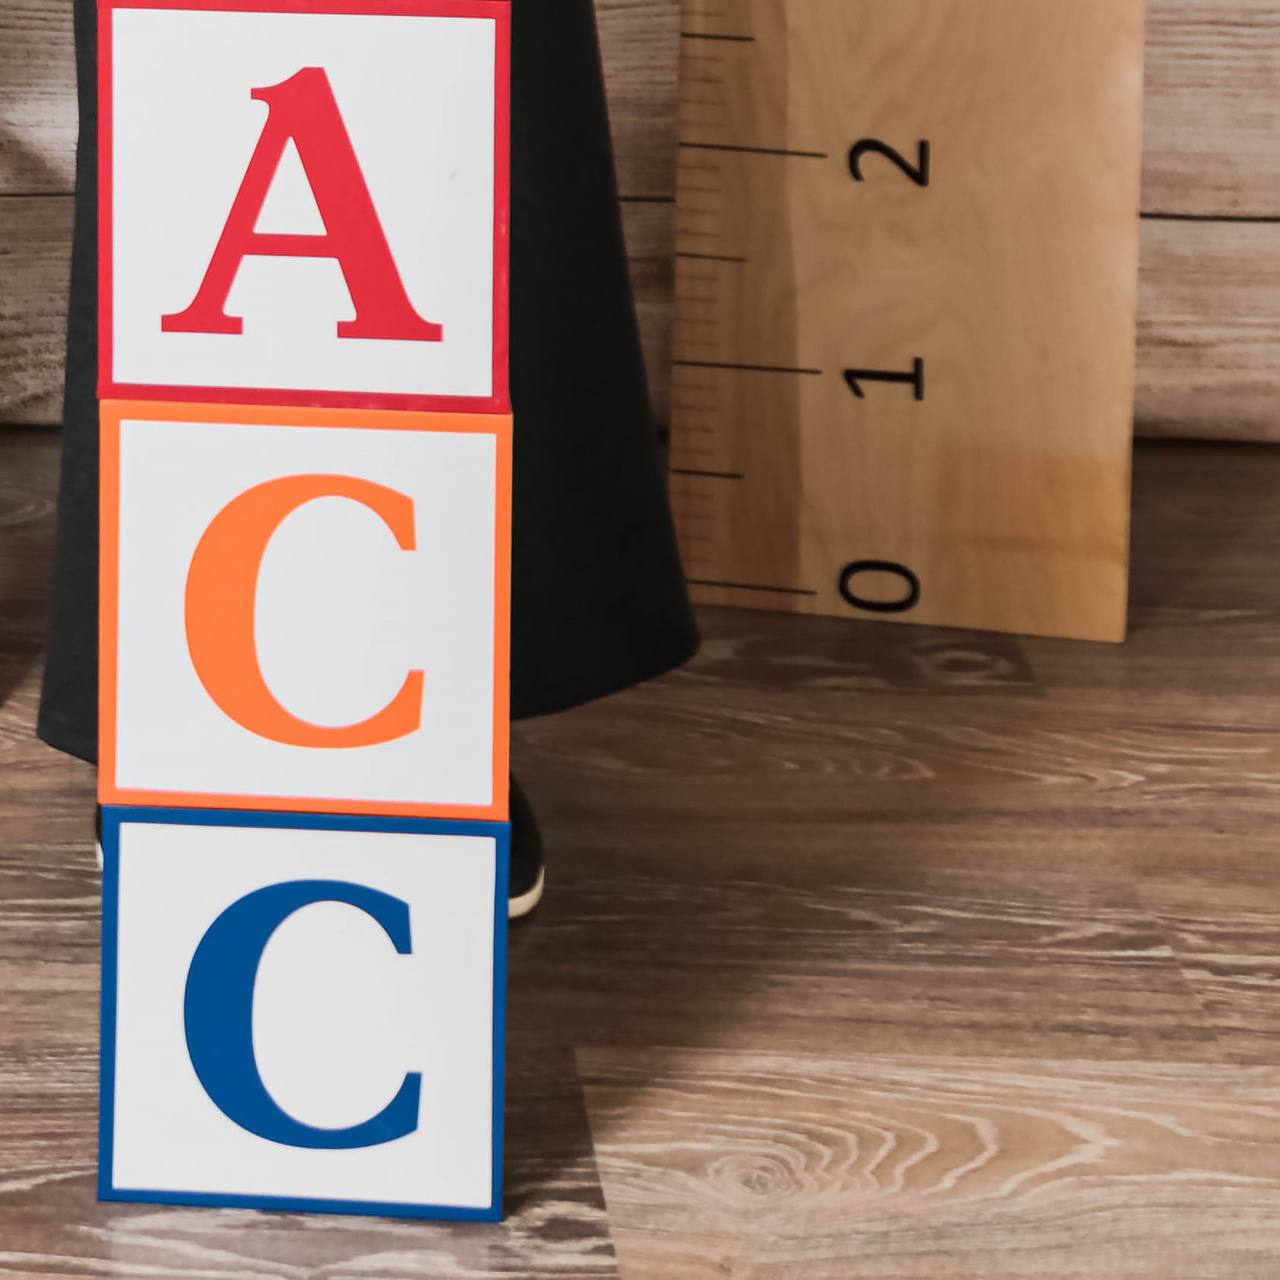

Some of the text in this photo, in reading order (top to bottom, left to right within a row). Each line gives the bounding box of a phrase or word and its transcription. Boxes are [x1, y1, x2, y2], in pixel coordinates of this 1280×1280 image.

[848, 138, 930, 188] 2
[842, 357, 924, 401] 1
[839, 560, 922, 614] 0
